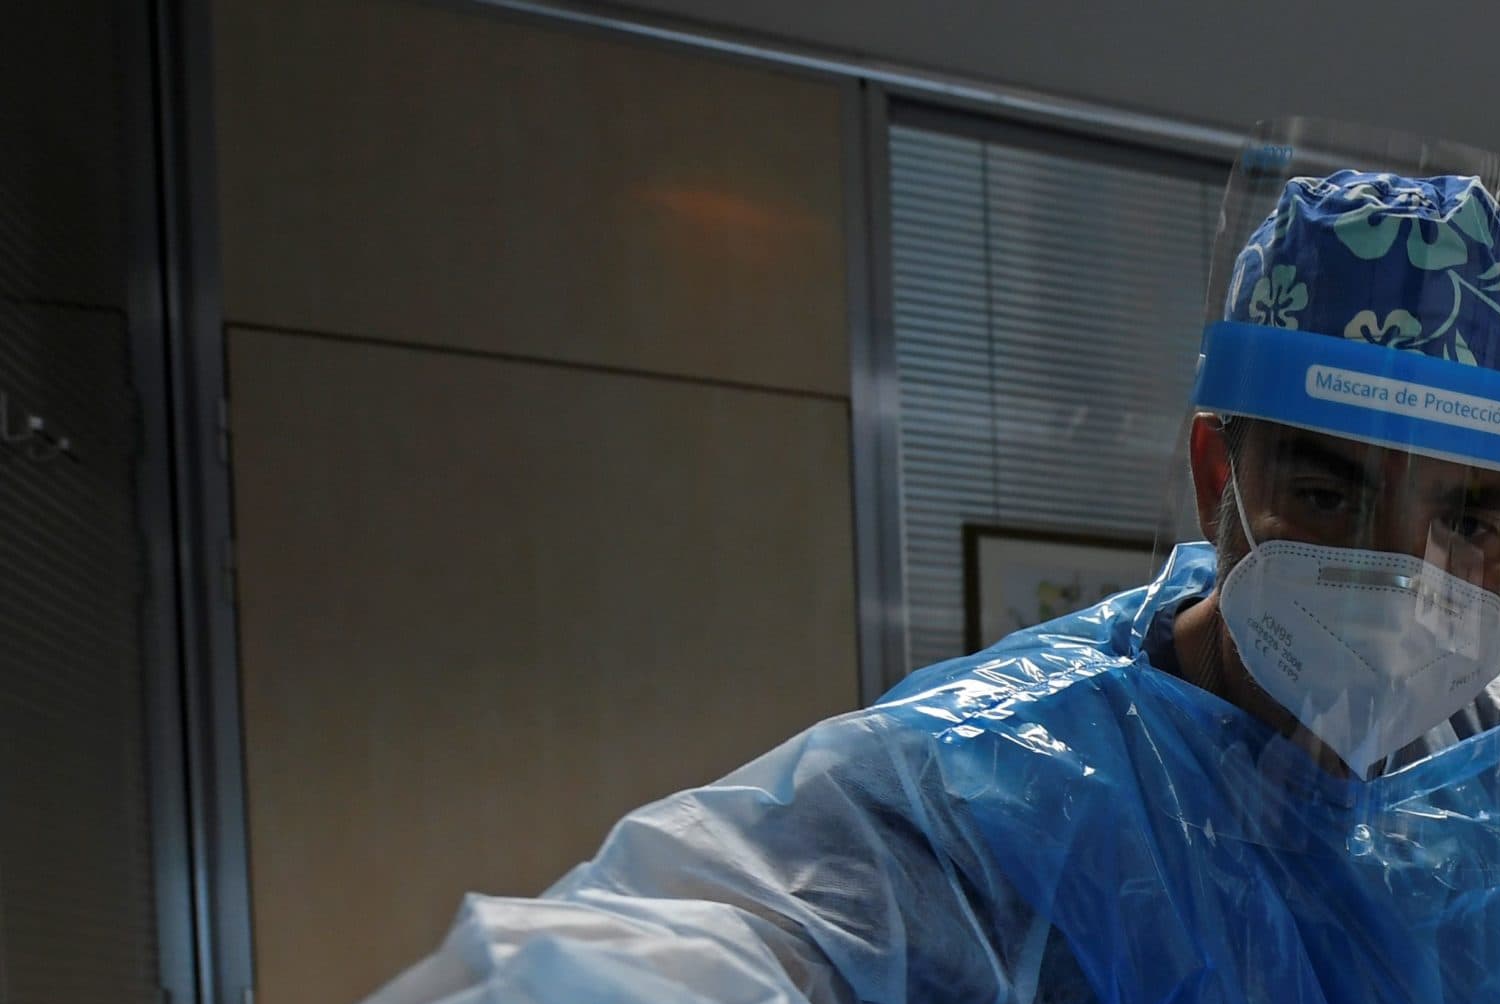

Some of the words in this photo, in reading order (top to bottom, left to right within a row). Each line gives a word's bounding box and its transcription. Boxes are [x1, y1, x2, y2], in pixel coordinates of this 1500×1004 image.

[1316, 370, 1388, 402] Máscara
[1396, 388, 1417, 407] de
[1262, 612, 1293, 647] KN95
